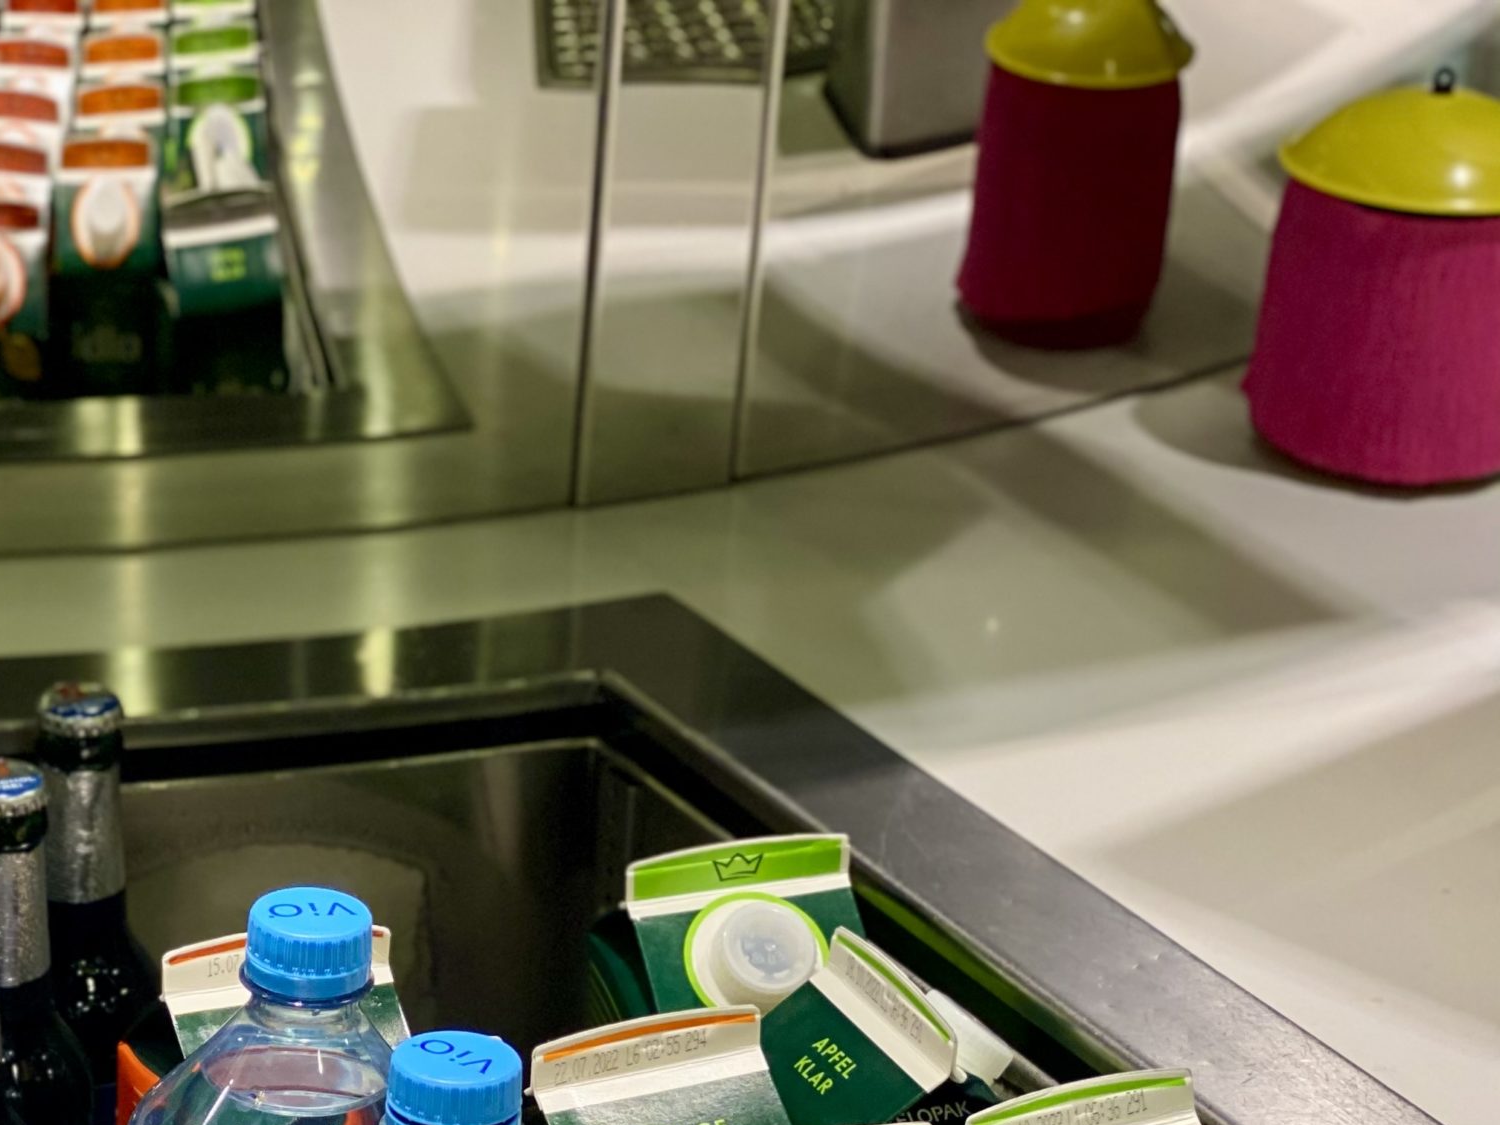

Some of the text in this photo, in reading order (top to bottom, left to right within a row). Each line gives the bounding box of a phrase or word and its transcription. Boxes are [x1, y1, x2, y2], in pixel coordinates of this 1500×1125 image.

[207, 954, 239, 978] 15.07
[554, 1056, 618, 1086] 22.07.2022
[793, 1055, 834, 1095] KLAR
[812, 1037, 858, 1080] APFEL
